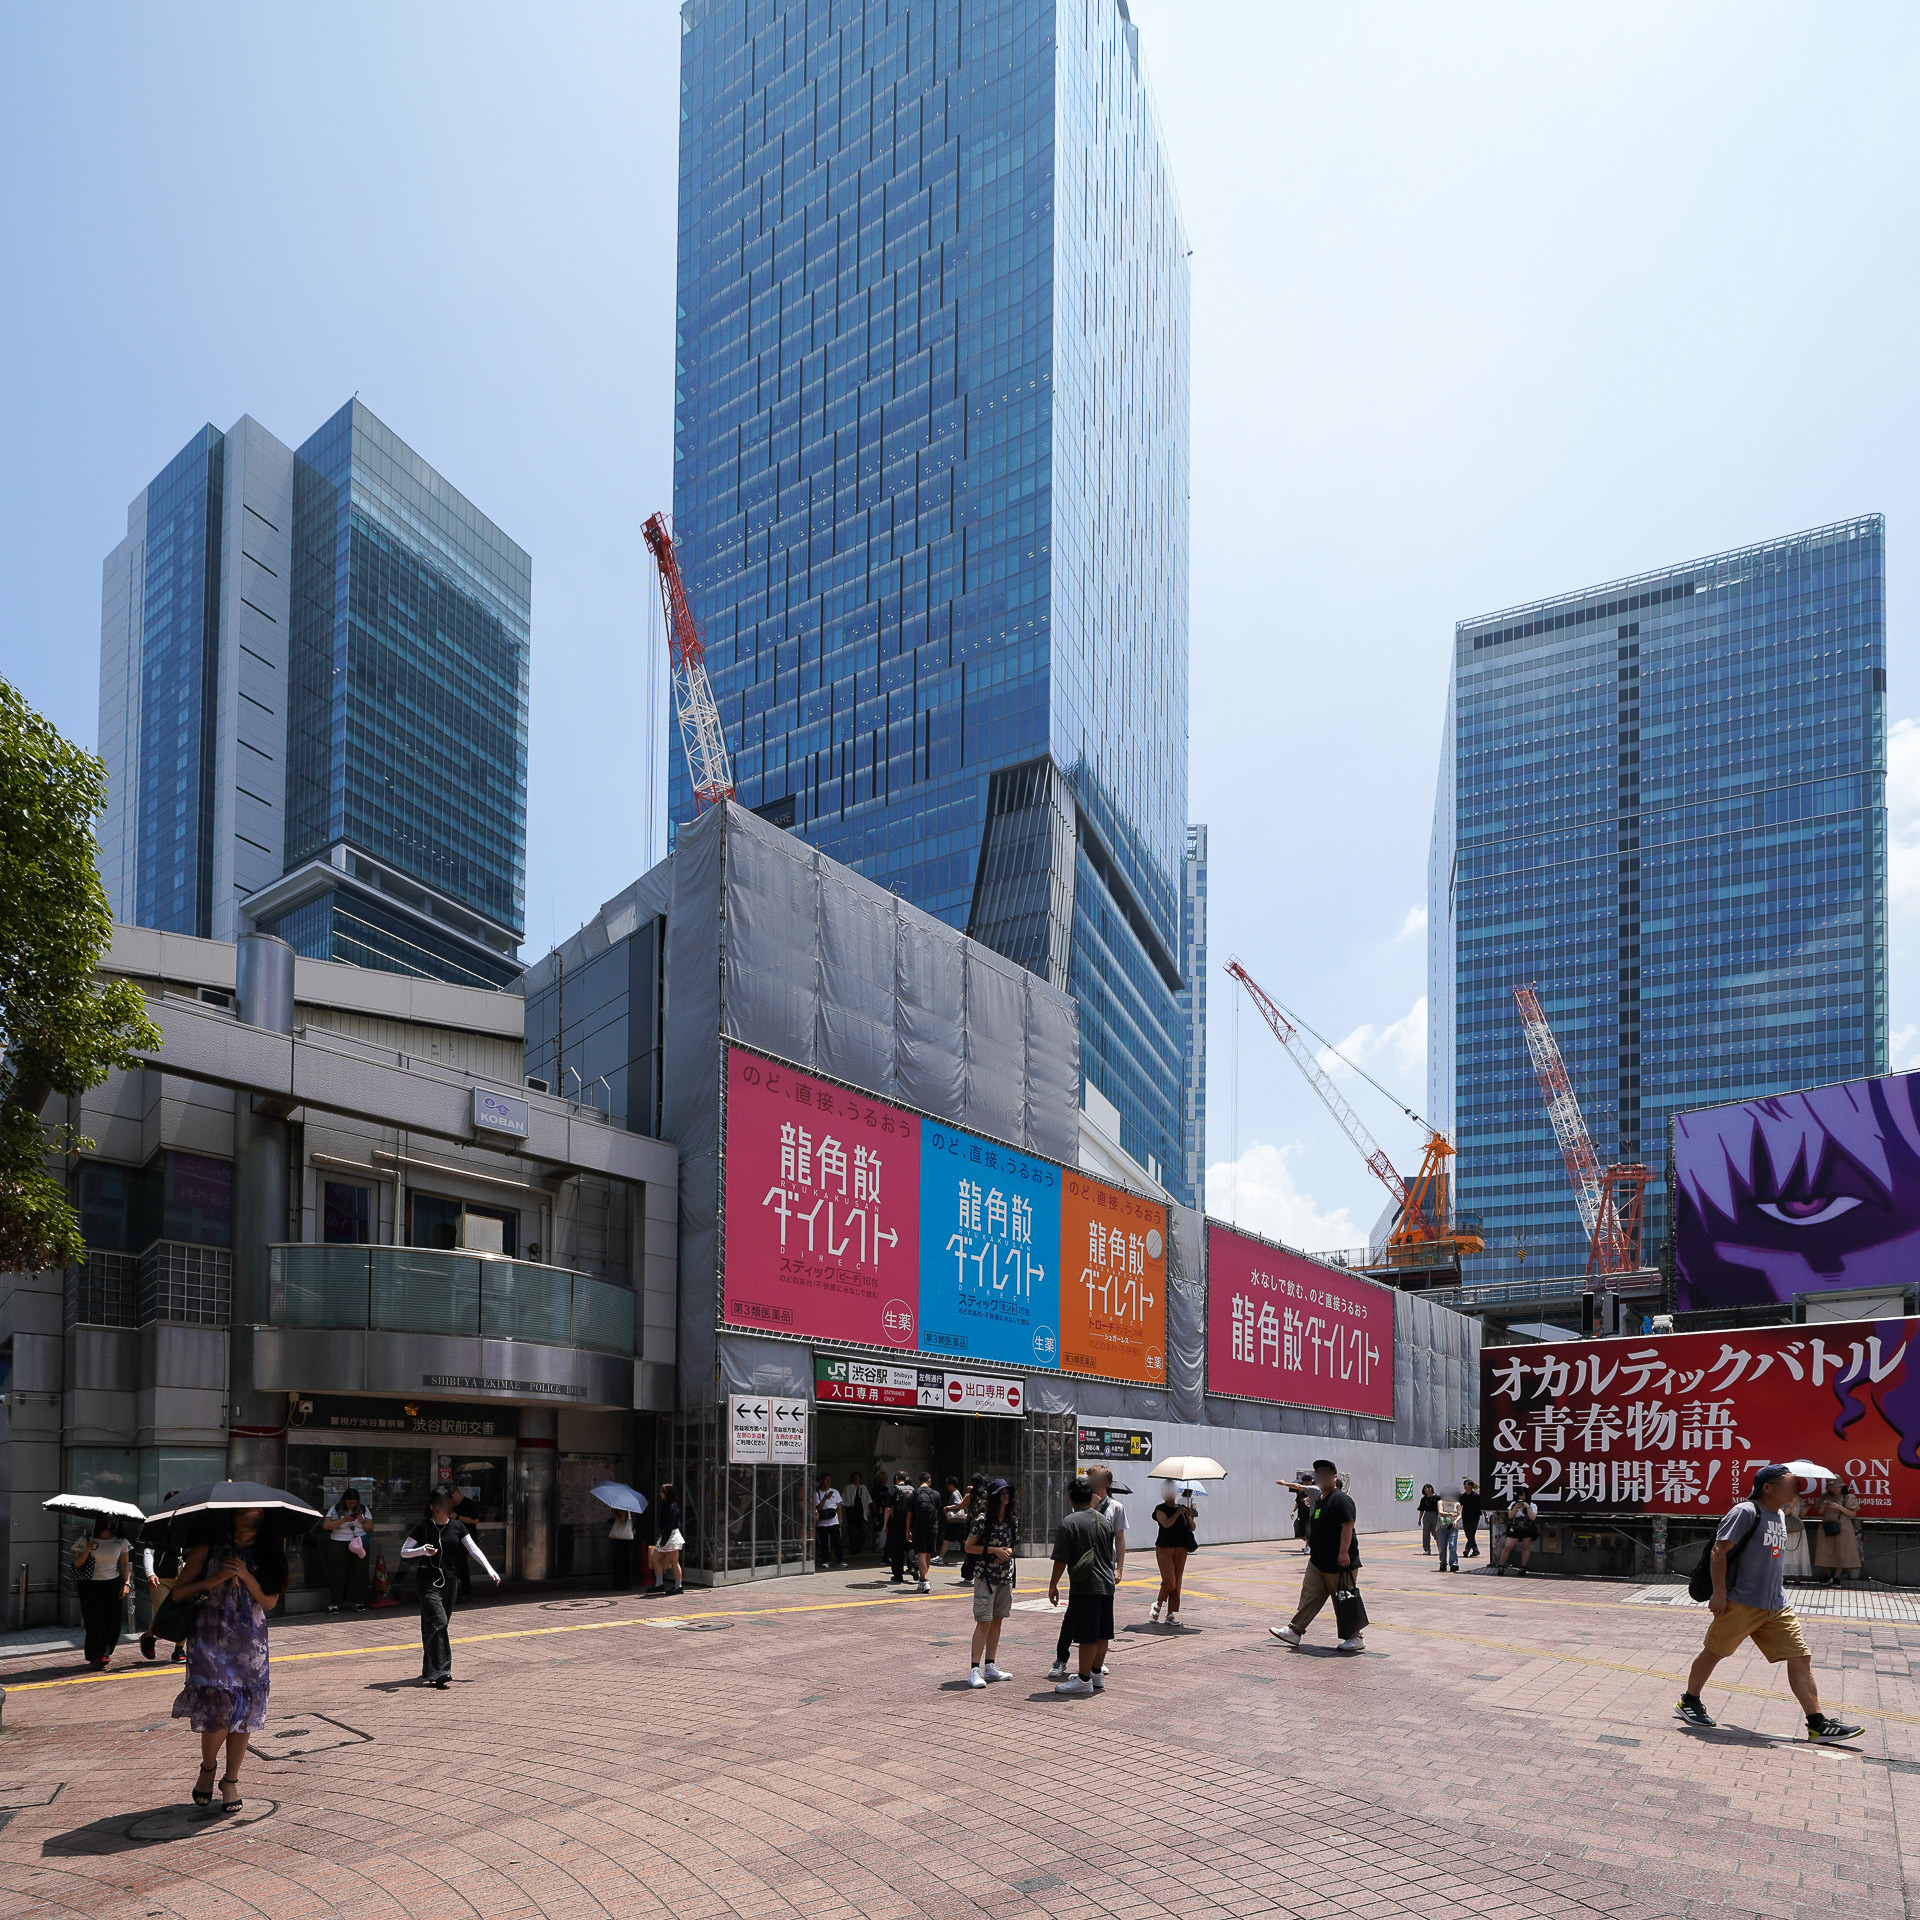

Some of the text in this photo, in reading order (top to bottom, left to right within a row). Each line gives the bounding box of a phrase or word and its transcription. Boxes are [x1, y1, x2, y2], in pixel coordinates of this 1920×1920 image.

[771, 811, 792, 825] ARE
[743, 1066, 911, 1138] のど、直接、うるおう
[480, 1112, 525, 1131] KOBAN
[780, 1121, 882, 1205] 龍角散
[932, 1133, 1054, 1187] のど、直接、うるおう
[780, 1180, 880, 1213] RYUKAKUSAN
[1069, 1181, 1161, 1225] のど、直接、うるおう
[959, 1178, 1033, 1245] 龍角散
[762, 1186, 899, 1266] ダイレクト
[958, 1227, 1031, 1252] RYUKAKUSAN
[1089, 1220, 1145, 1276] 龍角散
[780, 1246, 879, 1274] DIRECT
[945, 1233, 1045, 1297] ダイレクト
[780, 1257, 879, 1288] スティック ピーチ 16包
[958, 1284, 1030, 1304] DIRECT
[1080, 1268, 1154, 1322] ダイレクト
[1250, 1268, 1368, 1320] 水なしで飲む、のど直接うるおう
[733, 1302, 791, 1323] 第3類医薬品
[958, 1293, 998, 1311] スティック
[1018, 1306, 1030, 1316] 16包
[884, 1310, 912, 1331] 生薬
[1089, 1318, 1114, 1332] トローチ
[925, 1333, 967, 1348] 第3類医薬品
[1034, 1335, 1055, 1353] 生薬
[1104, 1333, 1129, 1344] シュガーレス
[827, 1362, 847, 1377] JR
[1146, 1354, 1162, 1370] 生薬
[1490, 1336, 1906, 1402] オカルティックバトル
[852, 1365, 888, 1384] 渋谷駅
[893, 1371, 913, 1380] Shibuya
[893, 1379, 912, 1387] Station
[918, 1372, 943, 1384] 左側通行
[431, 1376, 582, 1396] SHIBUYA-EKIMAE POLICE BOX
[831, 1384, 879, 1401] 入口専用
[884, 1389, 906, 1397] ENTRANCE
[965, 1382, 1005, 1400] 出口専用
[330, 1416, 496, 1435] 警視庁渋谷警察署 渋谷駅前交番
[1493, 1397, 1751, 1452] &青春物語、
[1131, 1442, 1140, 1450] A8
[1731, 1459, 1740, 1495] 2025
[1844, 1458, 1893, 1477] ON
[1848, 1479, 1893, 1495] AIR
[1763, 1532, 1779, 1548] DO
